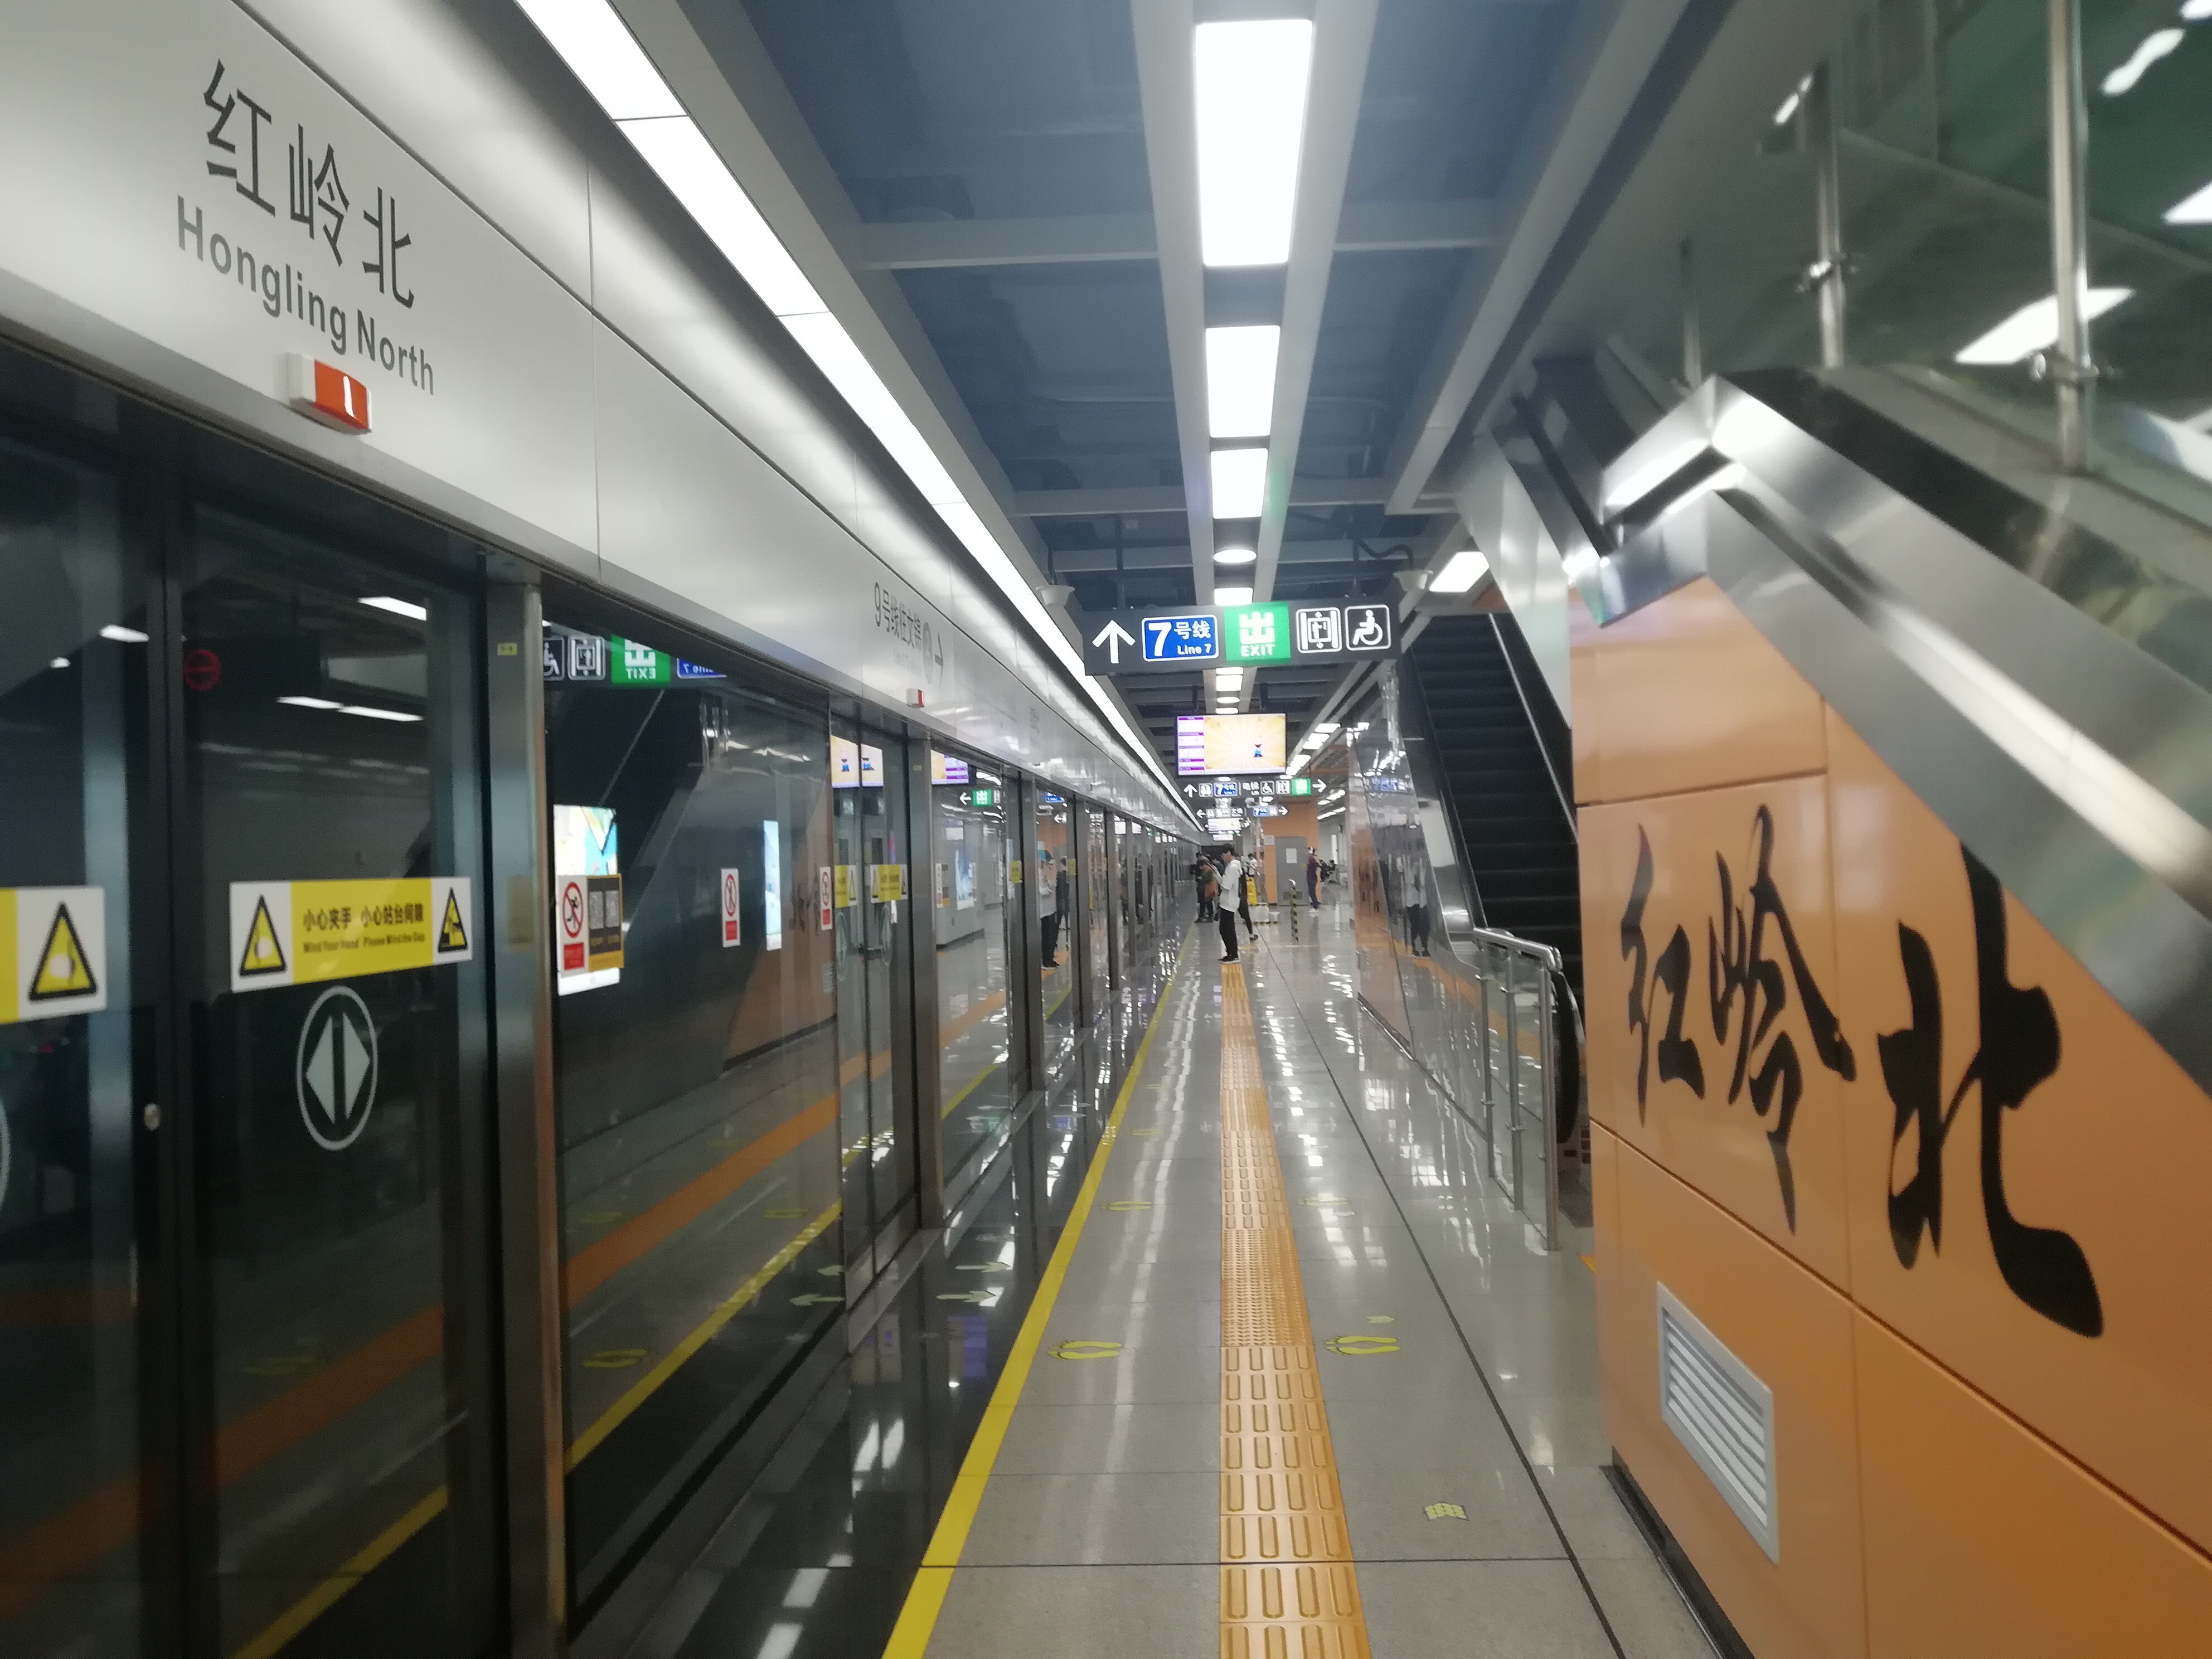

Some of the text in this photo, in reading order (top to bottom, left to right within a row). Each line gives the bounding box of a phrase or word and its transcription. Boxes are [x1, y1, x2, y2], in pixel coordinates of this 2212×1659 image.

[203, 59, 414, 308] 红岭北
[177, 195, 435, 395] Hongling North
[1177, 643, 1212, 655] Line 7
[1239, 612, 1275, 644] 出
[1241, 644, 1275, 657] EXIT
[1621, 803, 2103, 1338] 红岭北
